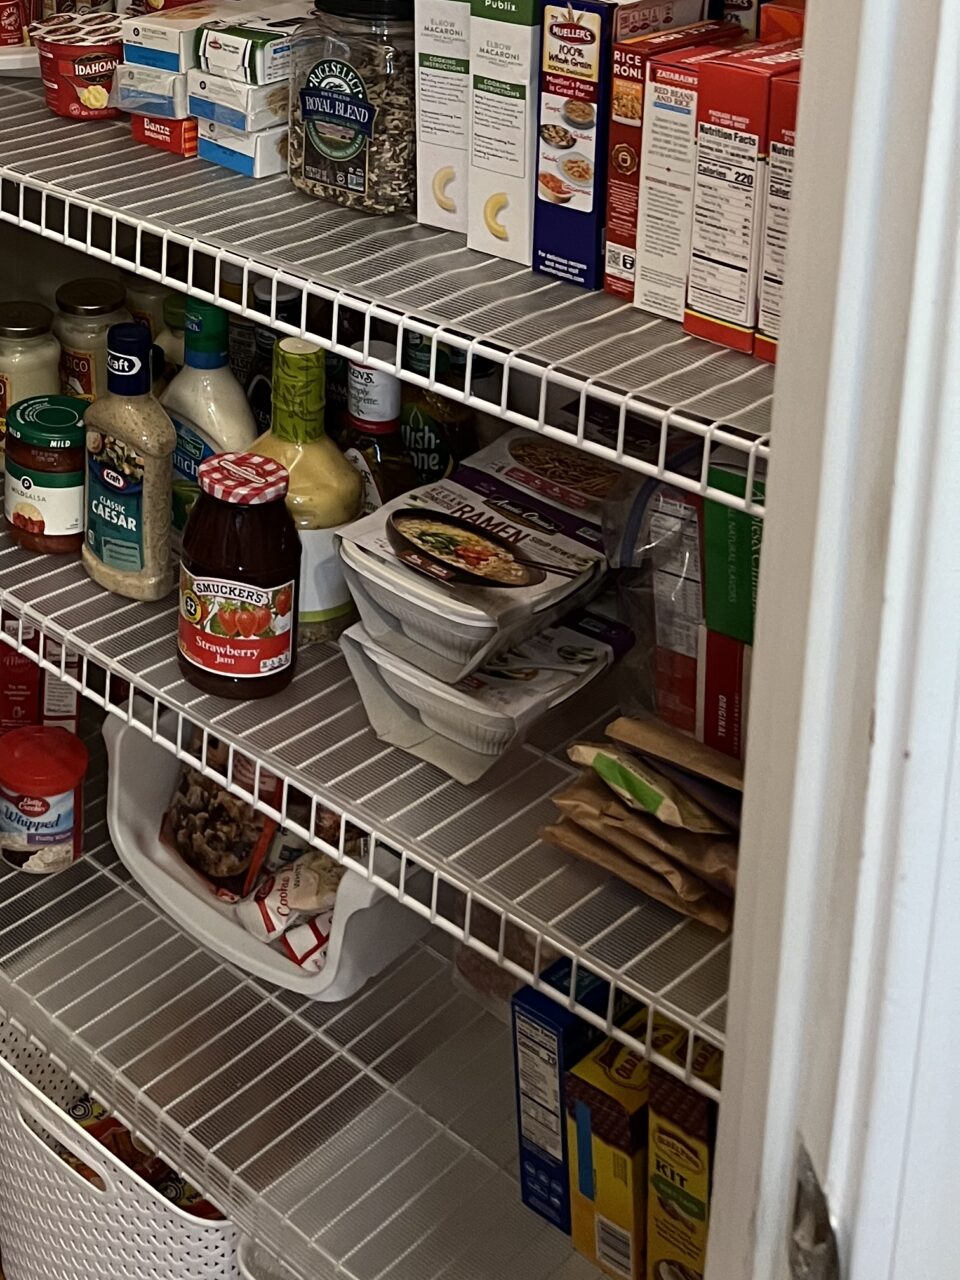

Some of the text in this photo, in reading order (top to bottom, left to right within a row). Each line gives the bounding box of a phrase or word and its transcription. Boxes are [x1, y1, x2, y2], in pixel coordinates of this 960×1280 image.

[423, 25, 464, 37] MACARONI
[552, 25, 592, 41] MUELLER'S
[478, 46, 520, 61] MACARONI
[485, 39, 512, 51] ELBOW
[558, 44, 585, 59] 100%
[570, 59, 592, 70] Grain
[613, 50, 643, 66] RICE
[74, 58, 120, 76] IDAHOAN
[546, 75, 594, 92] Mueller's Pasta
[555, 85, 574, 96] Great
[653, 85, 695, 102] RED BEANS
[655, 94, 691, 108] AND RICE
[305, 96, 369, 123] ROYAL BLEND
[699, 124, 757, 147] Nutrition Facts
[697, 164, 754, 186] Calories 220
[49, 440, 71, 449] MILD
[105, 470, 122, 485] Kraft
[99, 495, 127, 515] CLASSIC
[91, 500, 137, 532] CAESAR
[450, 503, 531, 546] RAMEN
[195, 582, 264, 604] SMUCKER'S
[186, 597, 196, 614] 32
[195, 635, 260, 659] Strawberry
[214, 653, 235, 665] Jam
[717, 694, 727, 738] ORIGINAL
[3, 805, 61, 832] Whipped
[655, 1160, 689, 1189] KIT
